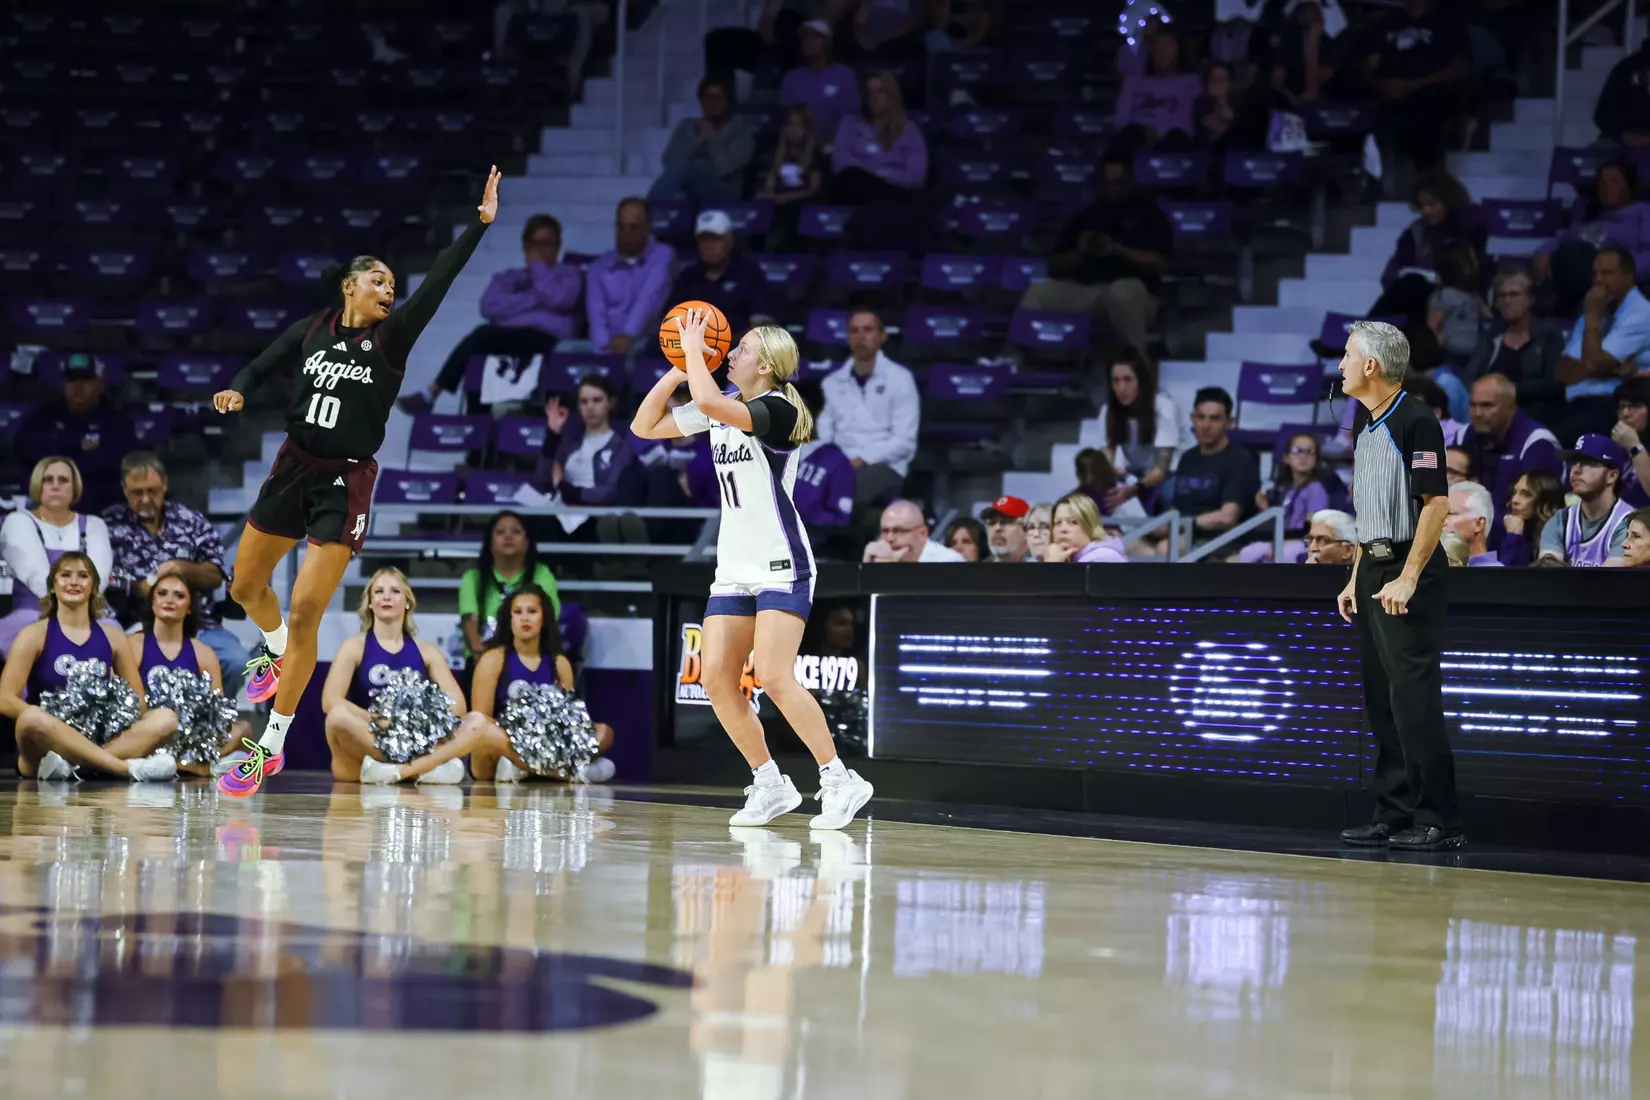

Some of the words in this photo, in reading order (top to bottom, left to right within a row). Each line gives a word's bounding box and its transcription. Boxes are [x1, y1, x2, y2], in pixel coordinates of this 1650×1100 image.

[303, 350, 374, 390] Aggies
[305, 393, 341, 430] 10
[720, 470, 742, 509] 11
[820, 655, 858, 691] 1979
